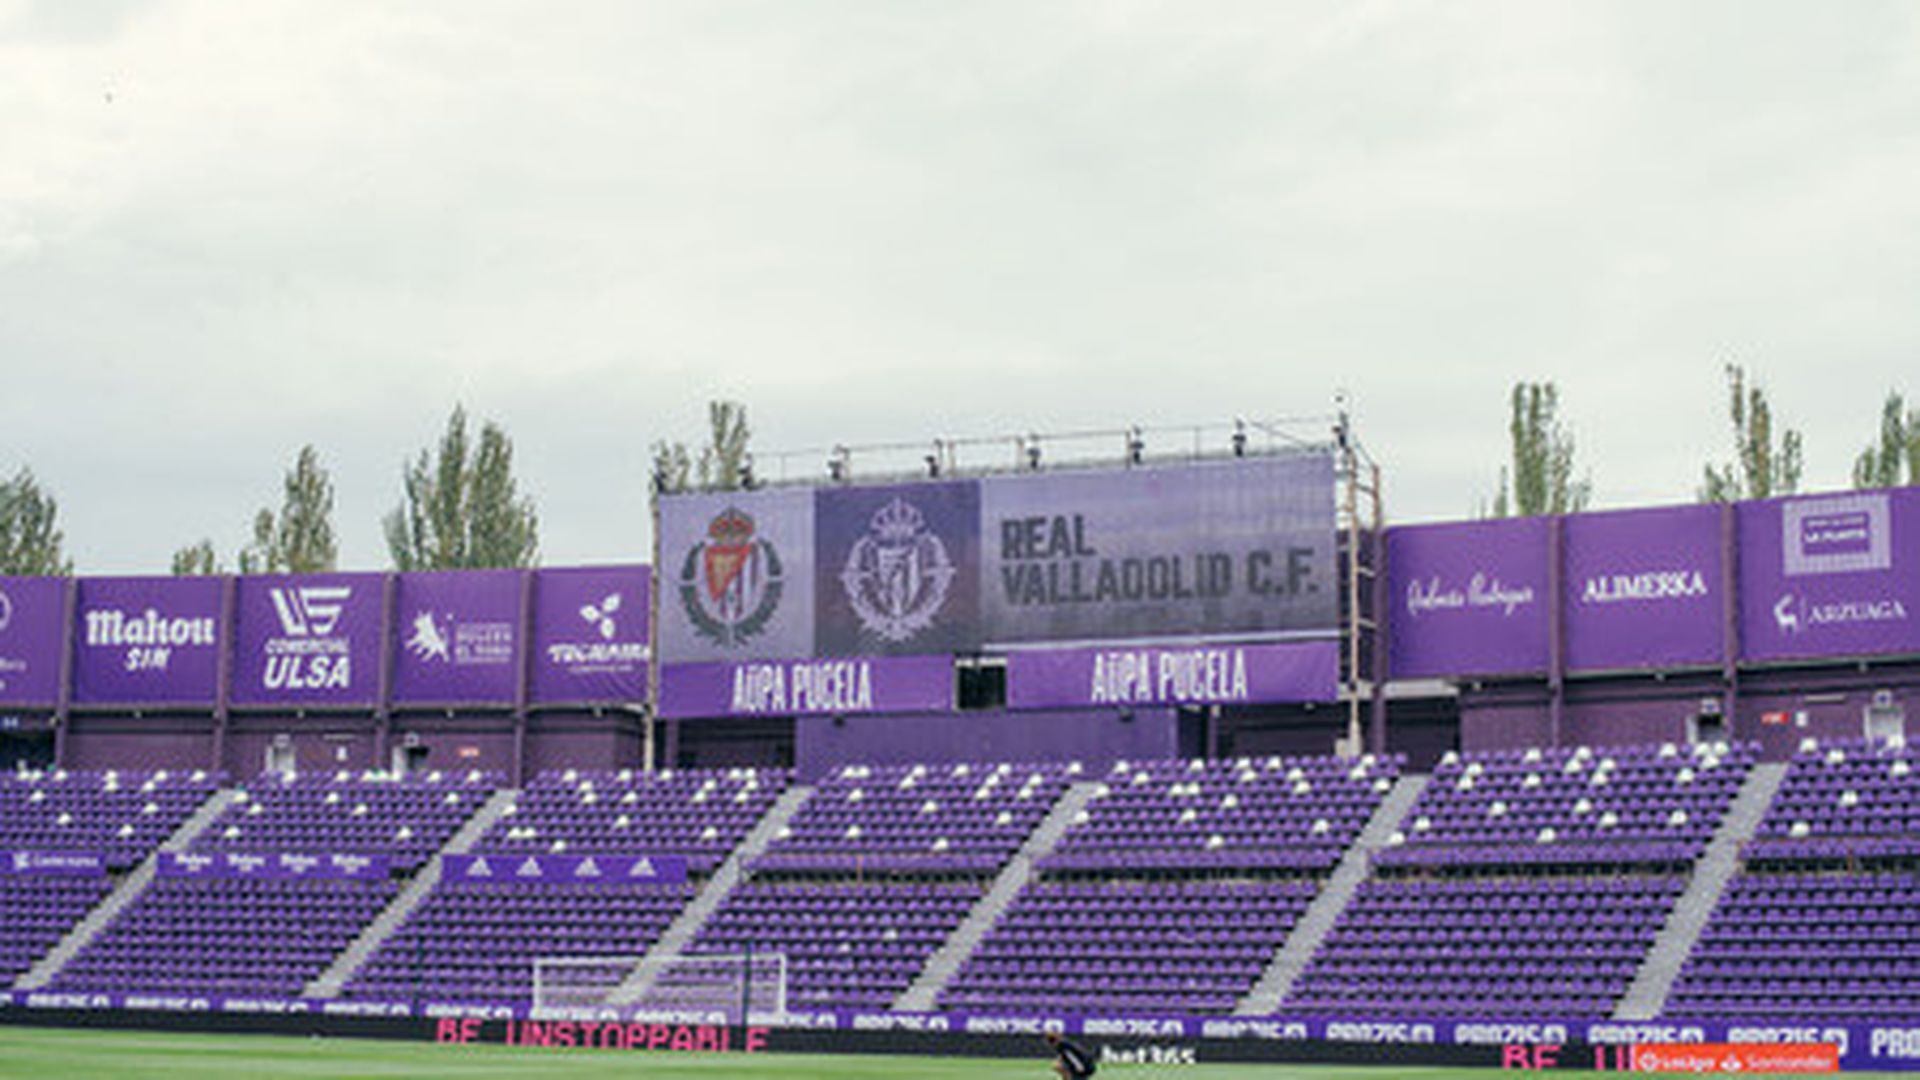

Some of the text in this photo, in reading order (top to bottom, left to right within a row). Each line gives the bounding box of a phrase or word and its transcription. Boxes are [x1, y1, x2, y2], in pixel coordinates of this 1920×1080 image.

[1001, 515, 1097, 560] REAL
[1001, 547, 1320, 605] VALLADOLID C.F.
[1582, 571, 1708, 602] ALIMERKA
[86, 608, 215, 646] Mahou
[1808, 600, 1907, 624] ARZUAGA
[124, 648, 171, 672] SIN
[263, 655, 349, 689] ULSA
[1158, 649, 1247, 701] PUCELA
[791, 661, 872, 710] PUCELA
[1100, 1044, 1197, 1065] bet365
[1748, 1053, 1832, 1069] Santander
